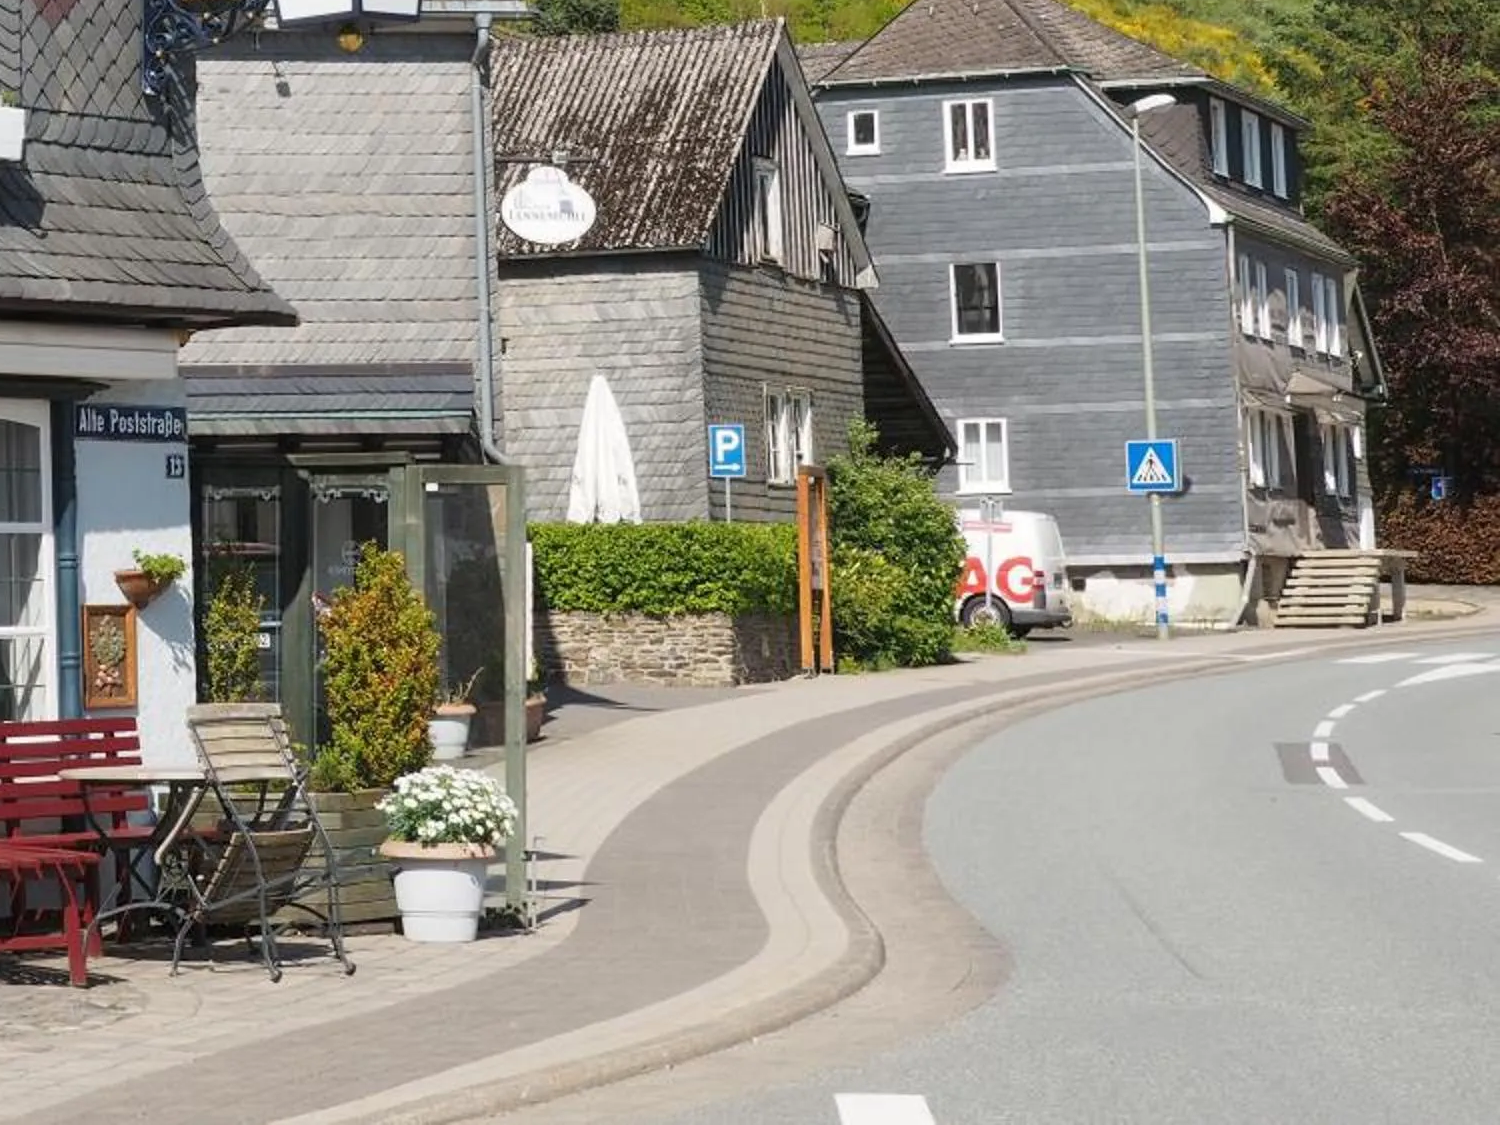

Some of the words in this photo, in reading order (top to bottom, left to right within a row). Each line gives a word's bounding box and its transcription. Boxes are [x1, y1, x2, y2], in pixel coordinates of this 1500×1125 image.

[79, 407, 105, 432] Alte
[109, 409, 181, 437] Poststraße
[715, 429, 739, 463] P
